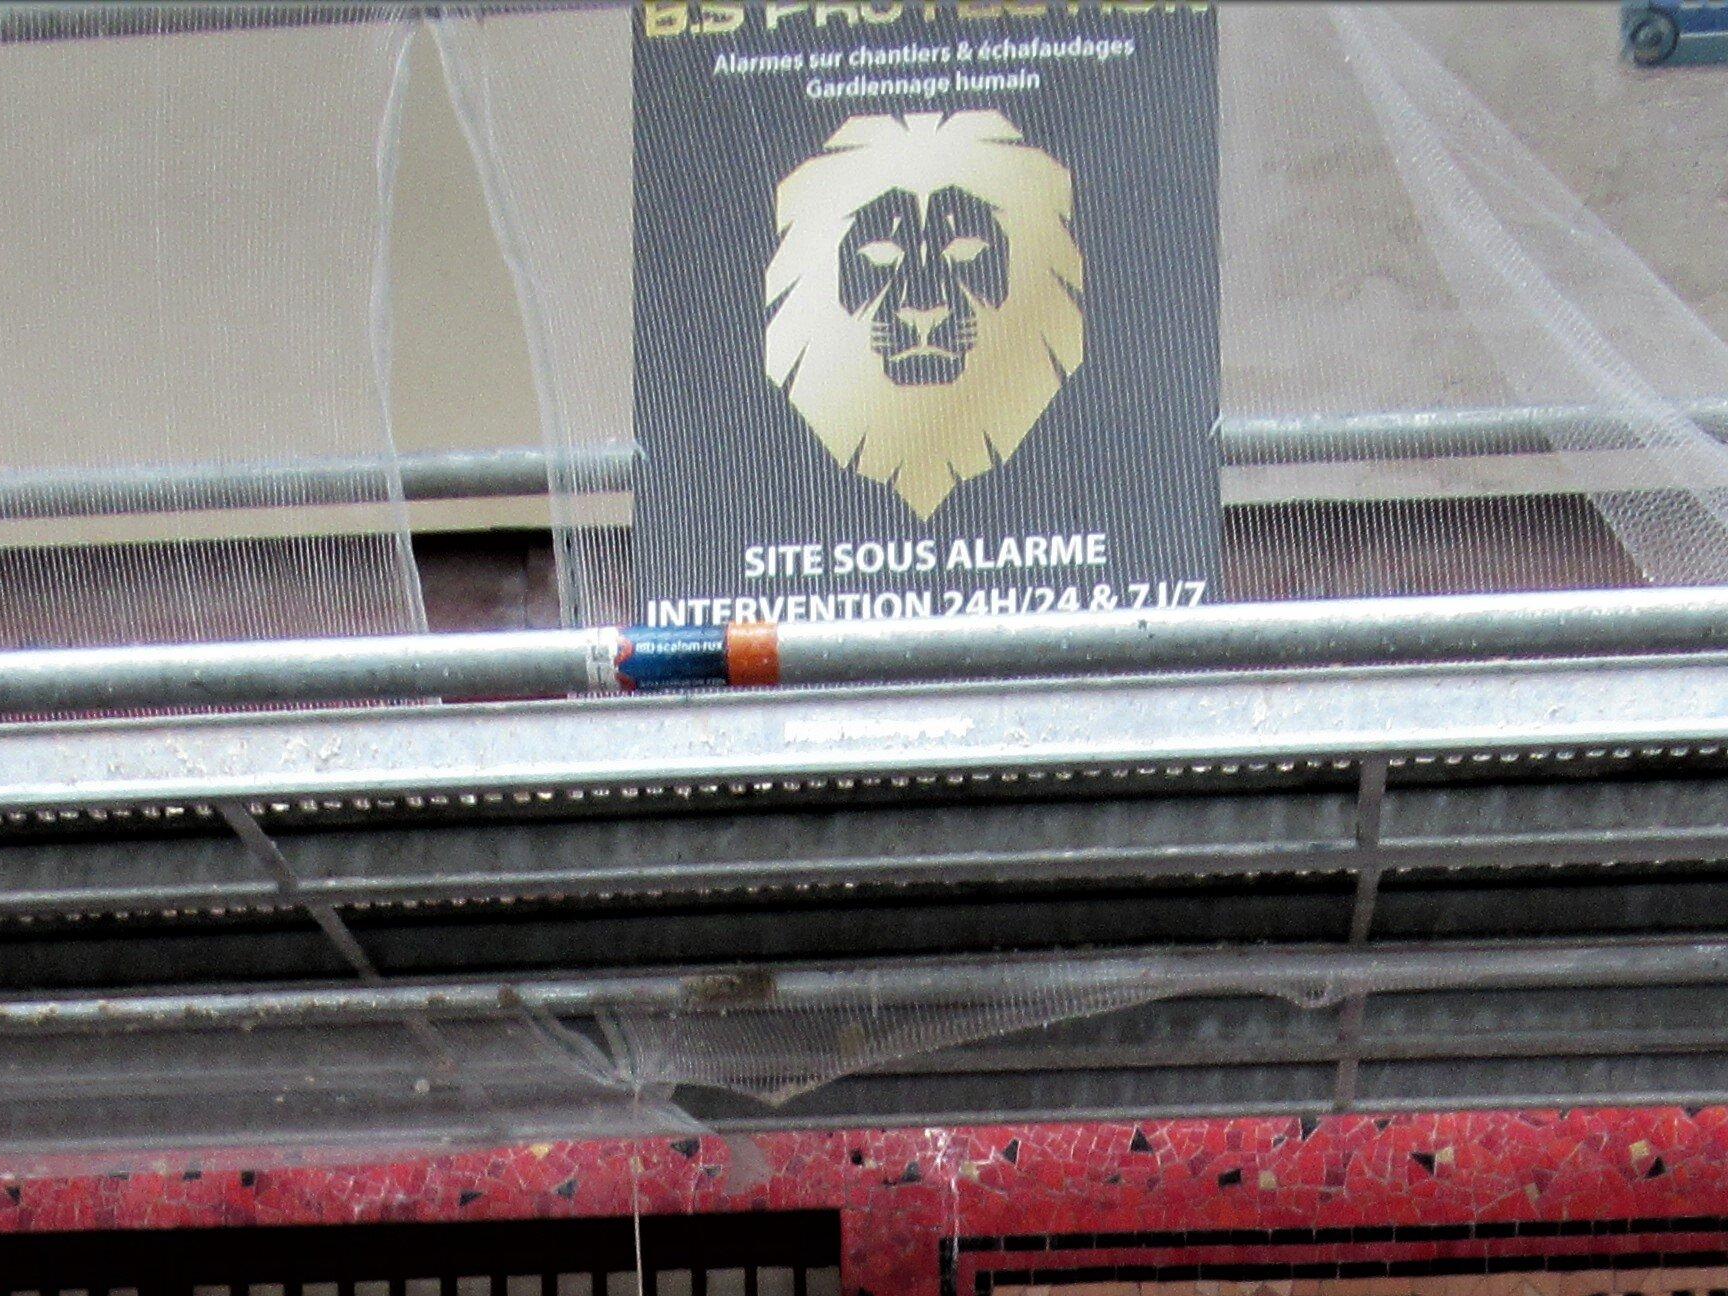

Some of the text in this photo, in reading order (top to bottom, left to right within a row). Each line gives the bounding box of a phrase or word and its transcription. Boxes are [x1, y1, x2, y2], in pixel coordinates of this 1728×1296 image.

[713, 36, 1135, 75] Alarmes sur chantiers & échafaudages
[805, 68, 1040, 100] Gardiennage humain
[744, 533, 1108, 579] SITE SOUS ALARME
[646, 590, 930, 628] INTERVENTION
[943, 584, 1080, 617] 24H/24
[1089, 582, 1118, 613] &
